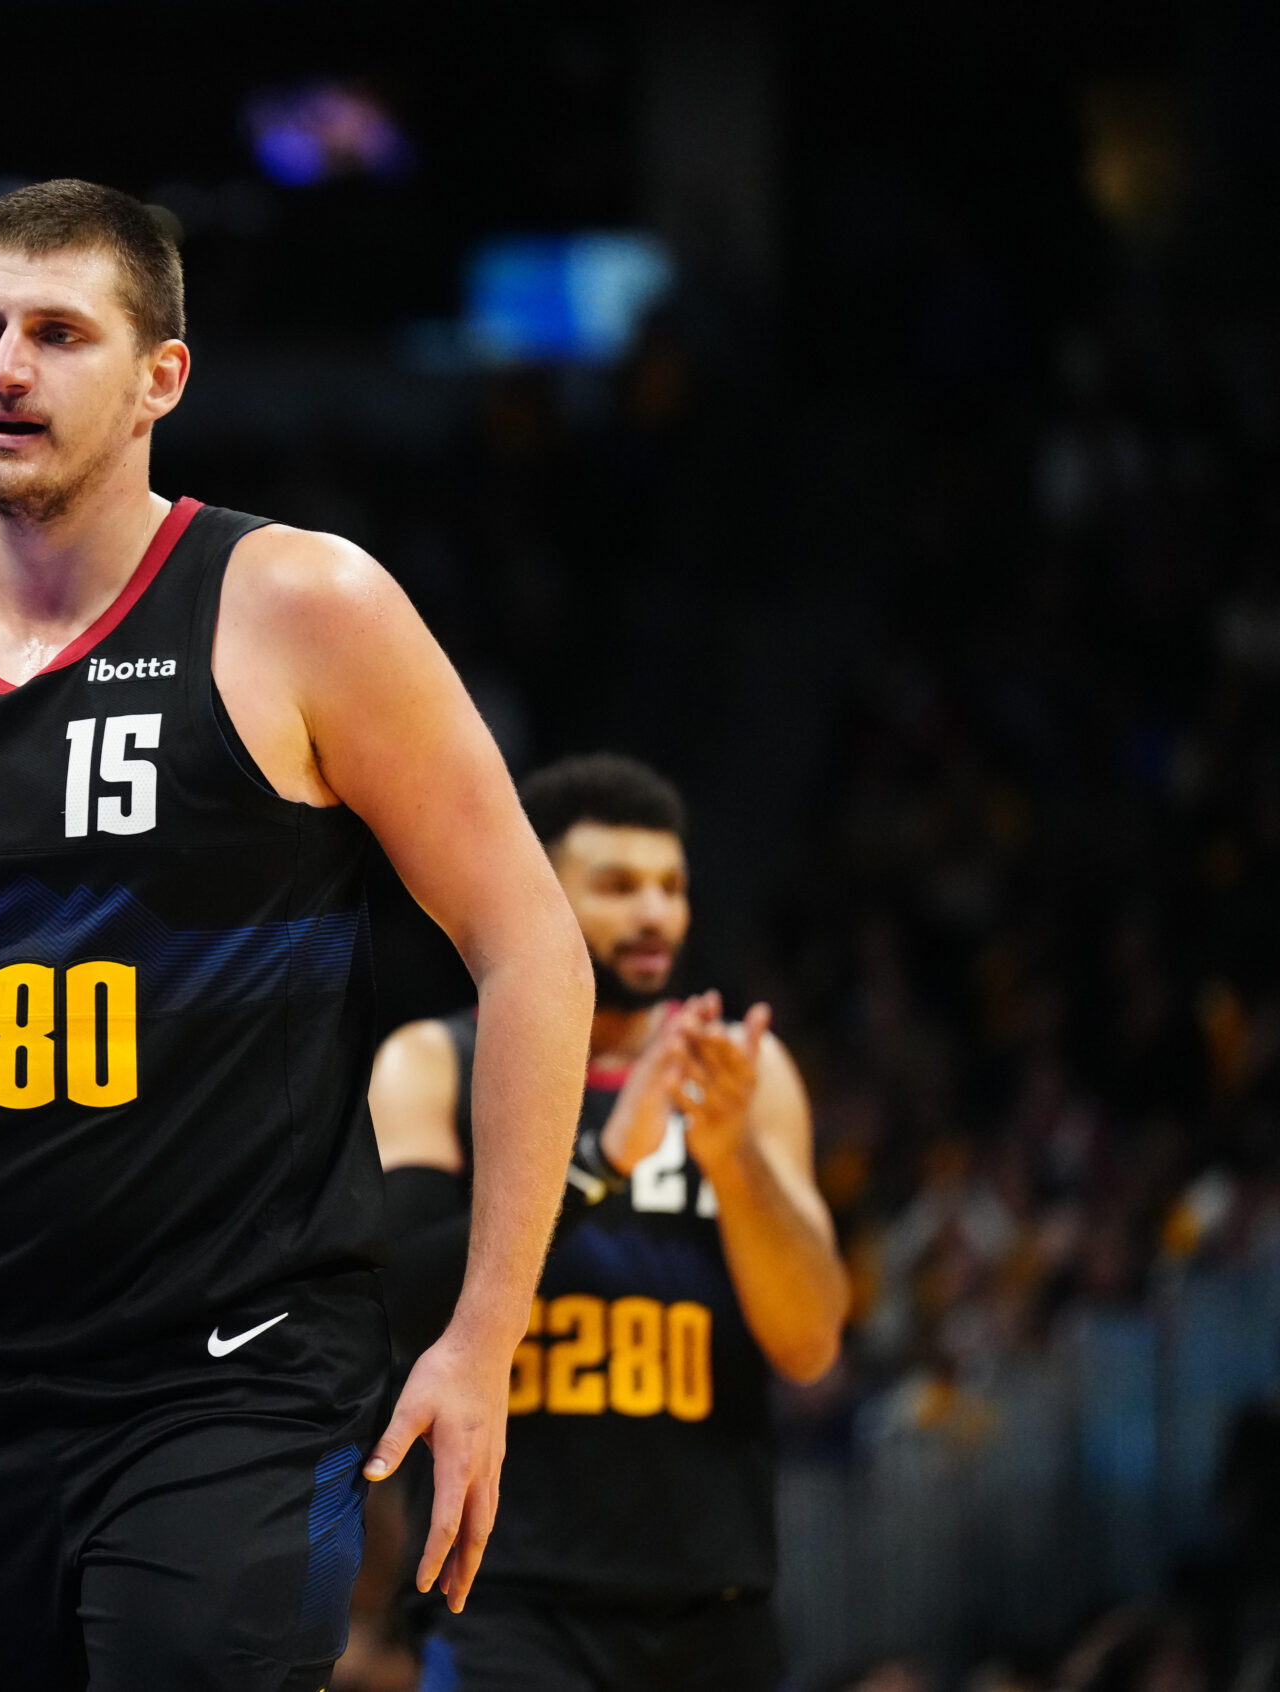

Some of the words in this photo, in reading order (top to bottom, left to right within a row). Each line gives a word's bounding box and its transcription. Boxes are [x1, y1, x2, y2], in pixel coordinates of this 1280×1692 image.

[87, 657, 176, 682] ibotta
[64, 713, 163, 838] 15
[631, 1112, 719, 1218] 2
